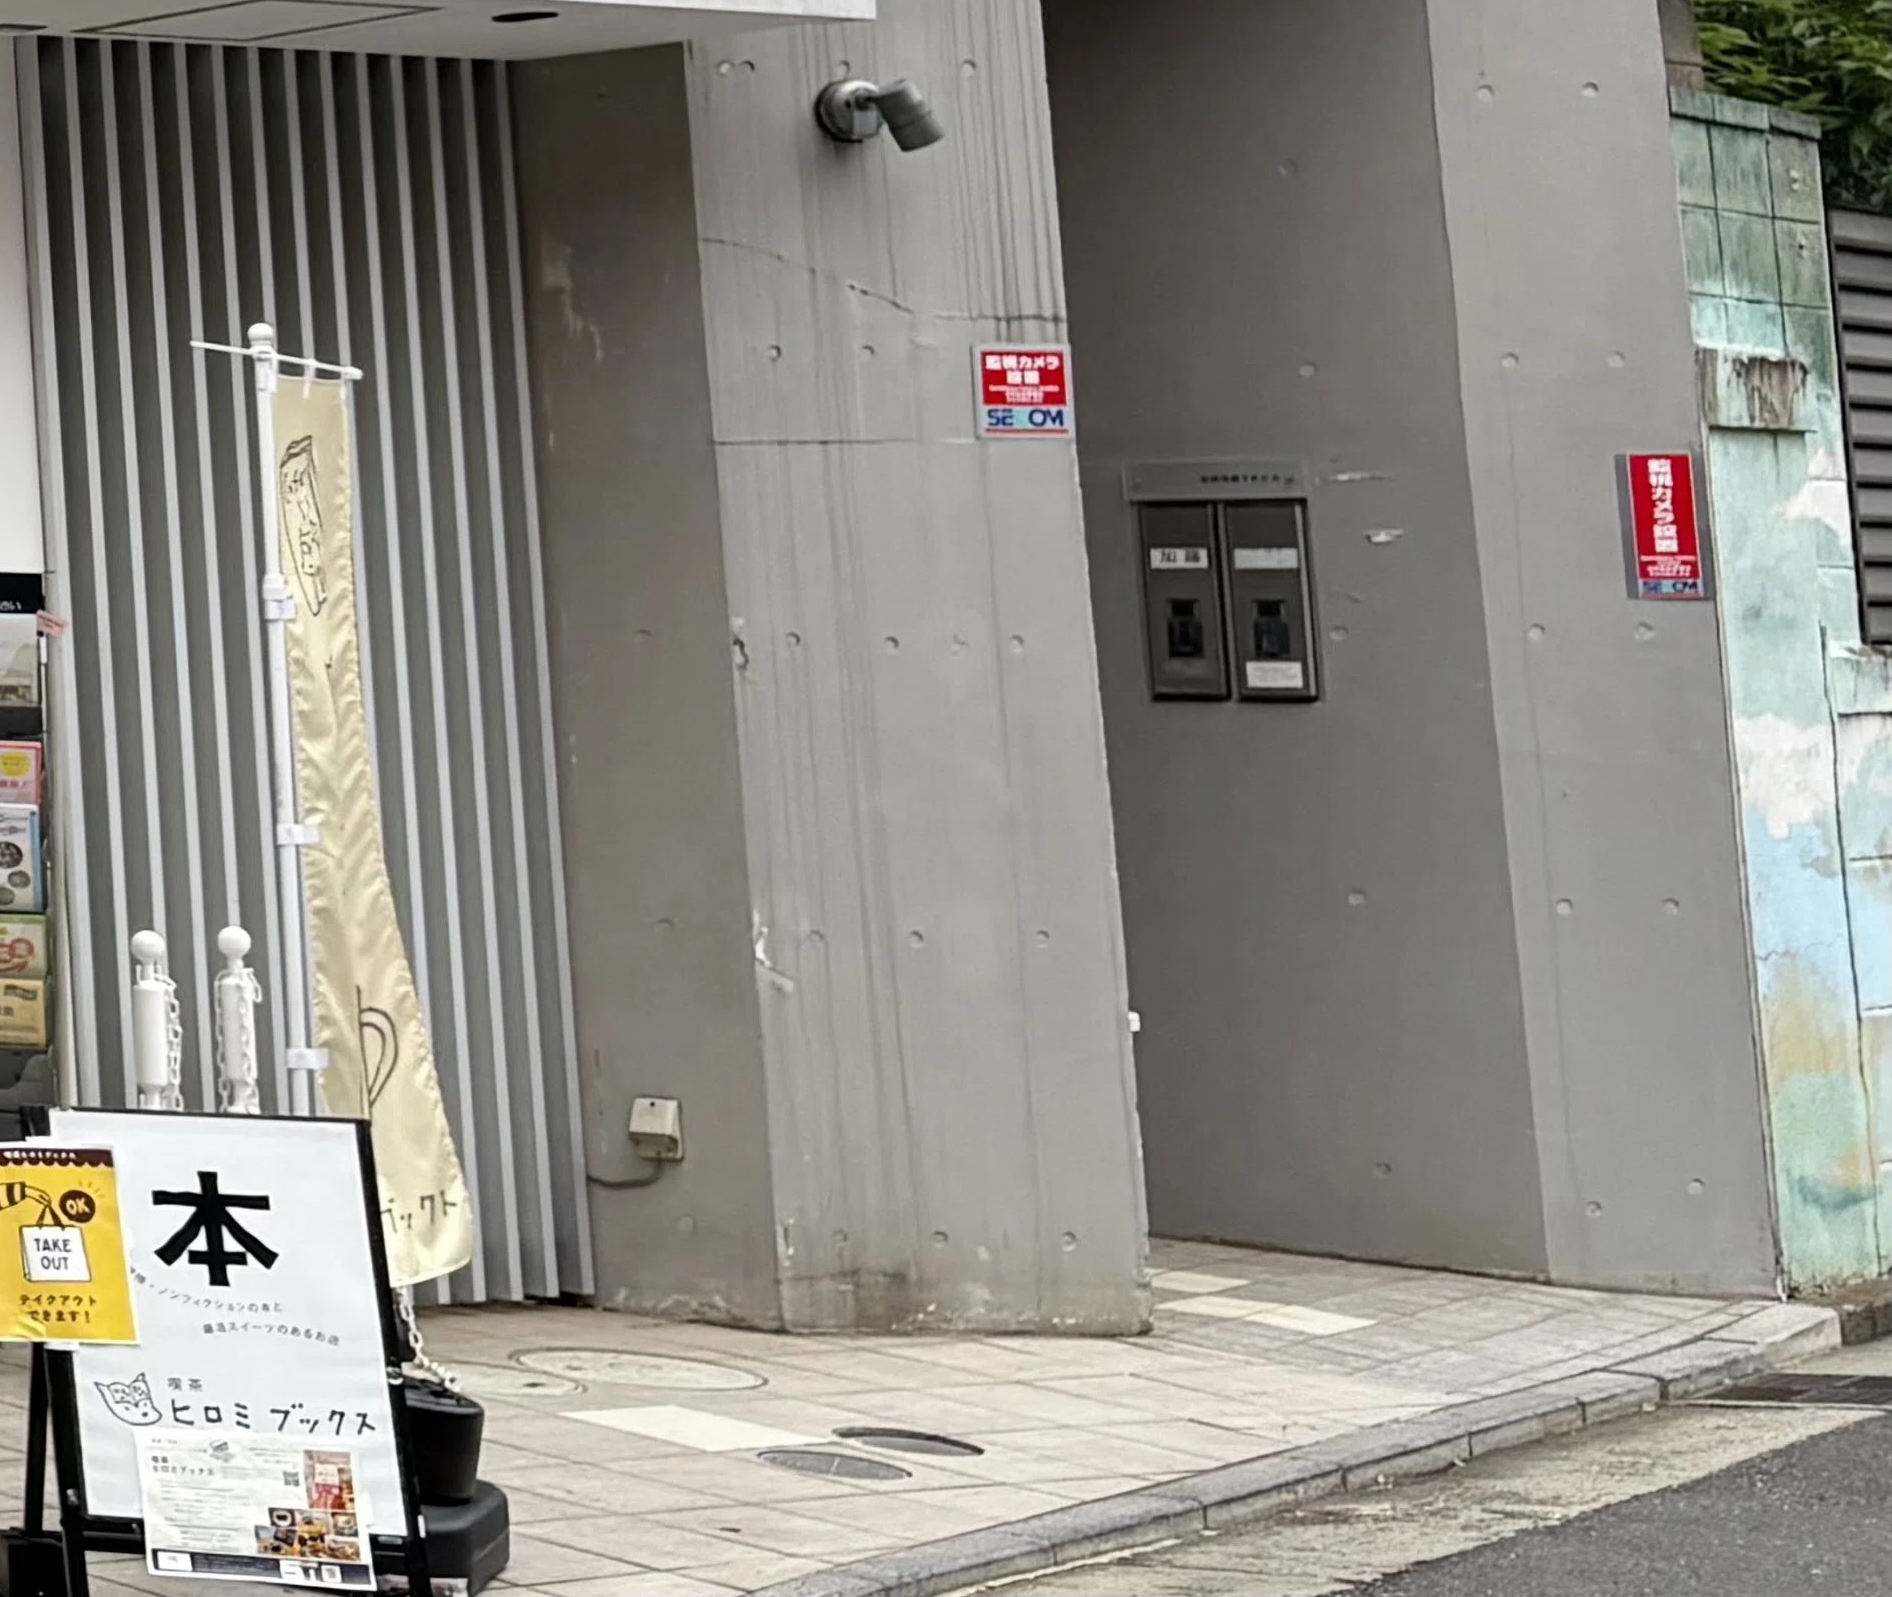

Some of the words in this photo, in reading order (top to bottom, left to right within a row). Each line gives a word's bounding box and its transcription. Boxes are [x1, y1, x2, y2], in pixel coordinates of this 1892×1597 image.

[65, 1197, 92, 1215] OK
[152, 1170, 279, 1287] 本
[33, 1238, 72, 1253] TAKE
[40, 1256, 70, 1271] OUT
[20, 1294, 97, 1307] テイクアウト
[167, 1377, 204, 1393] 喫茶
